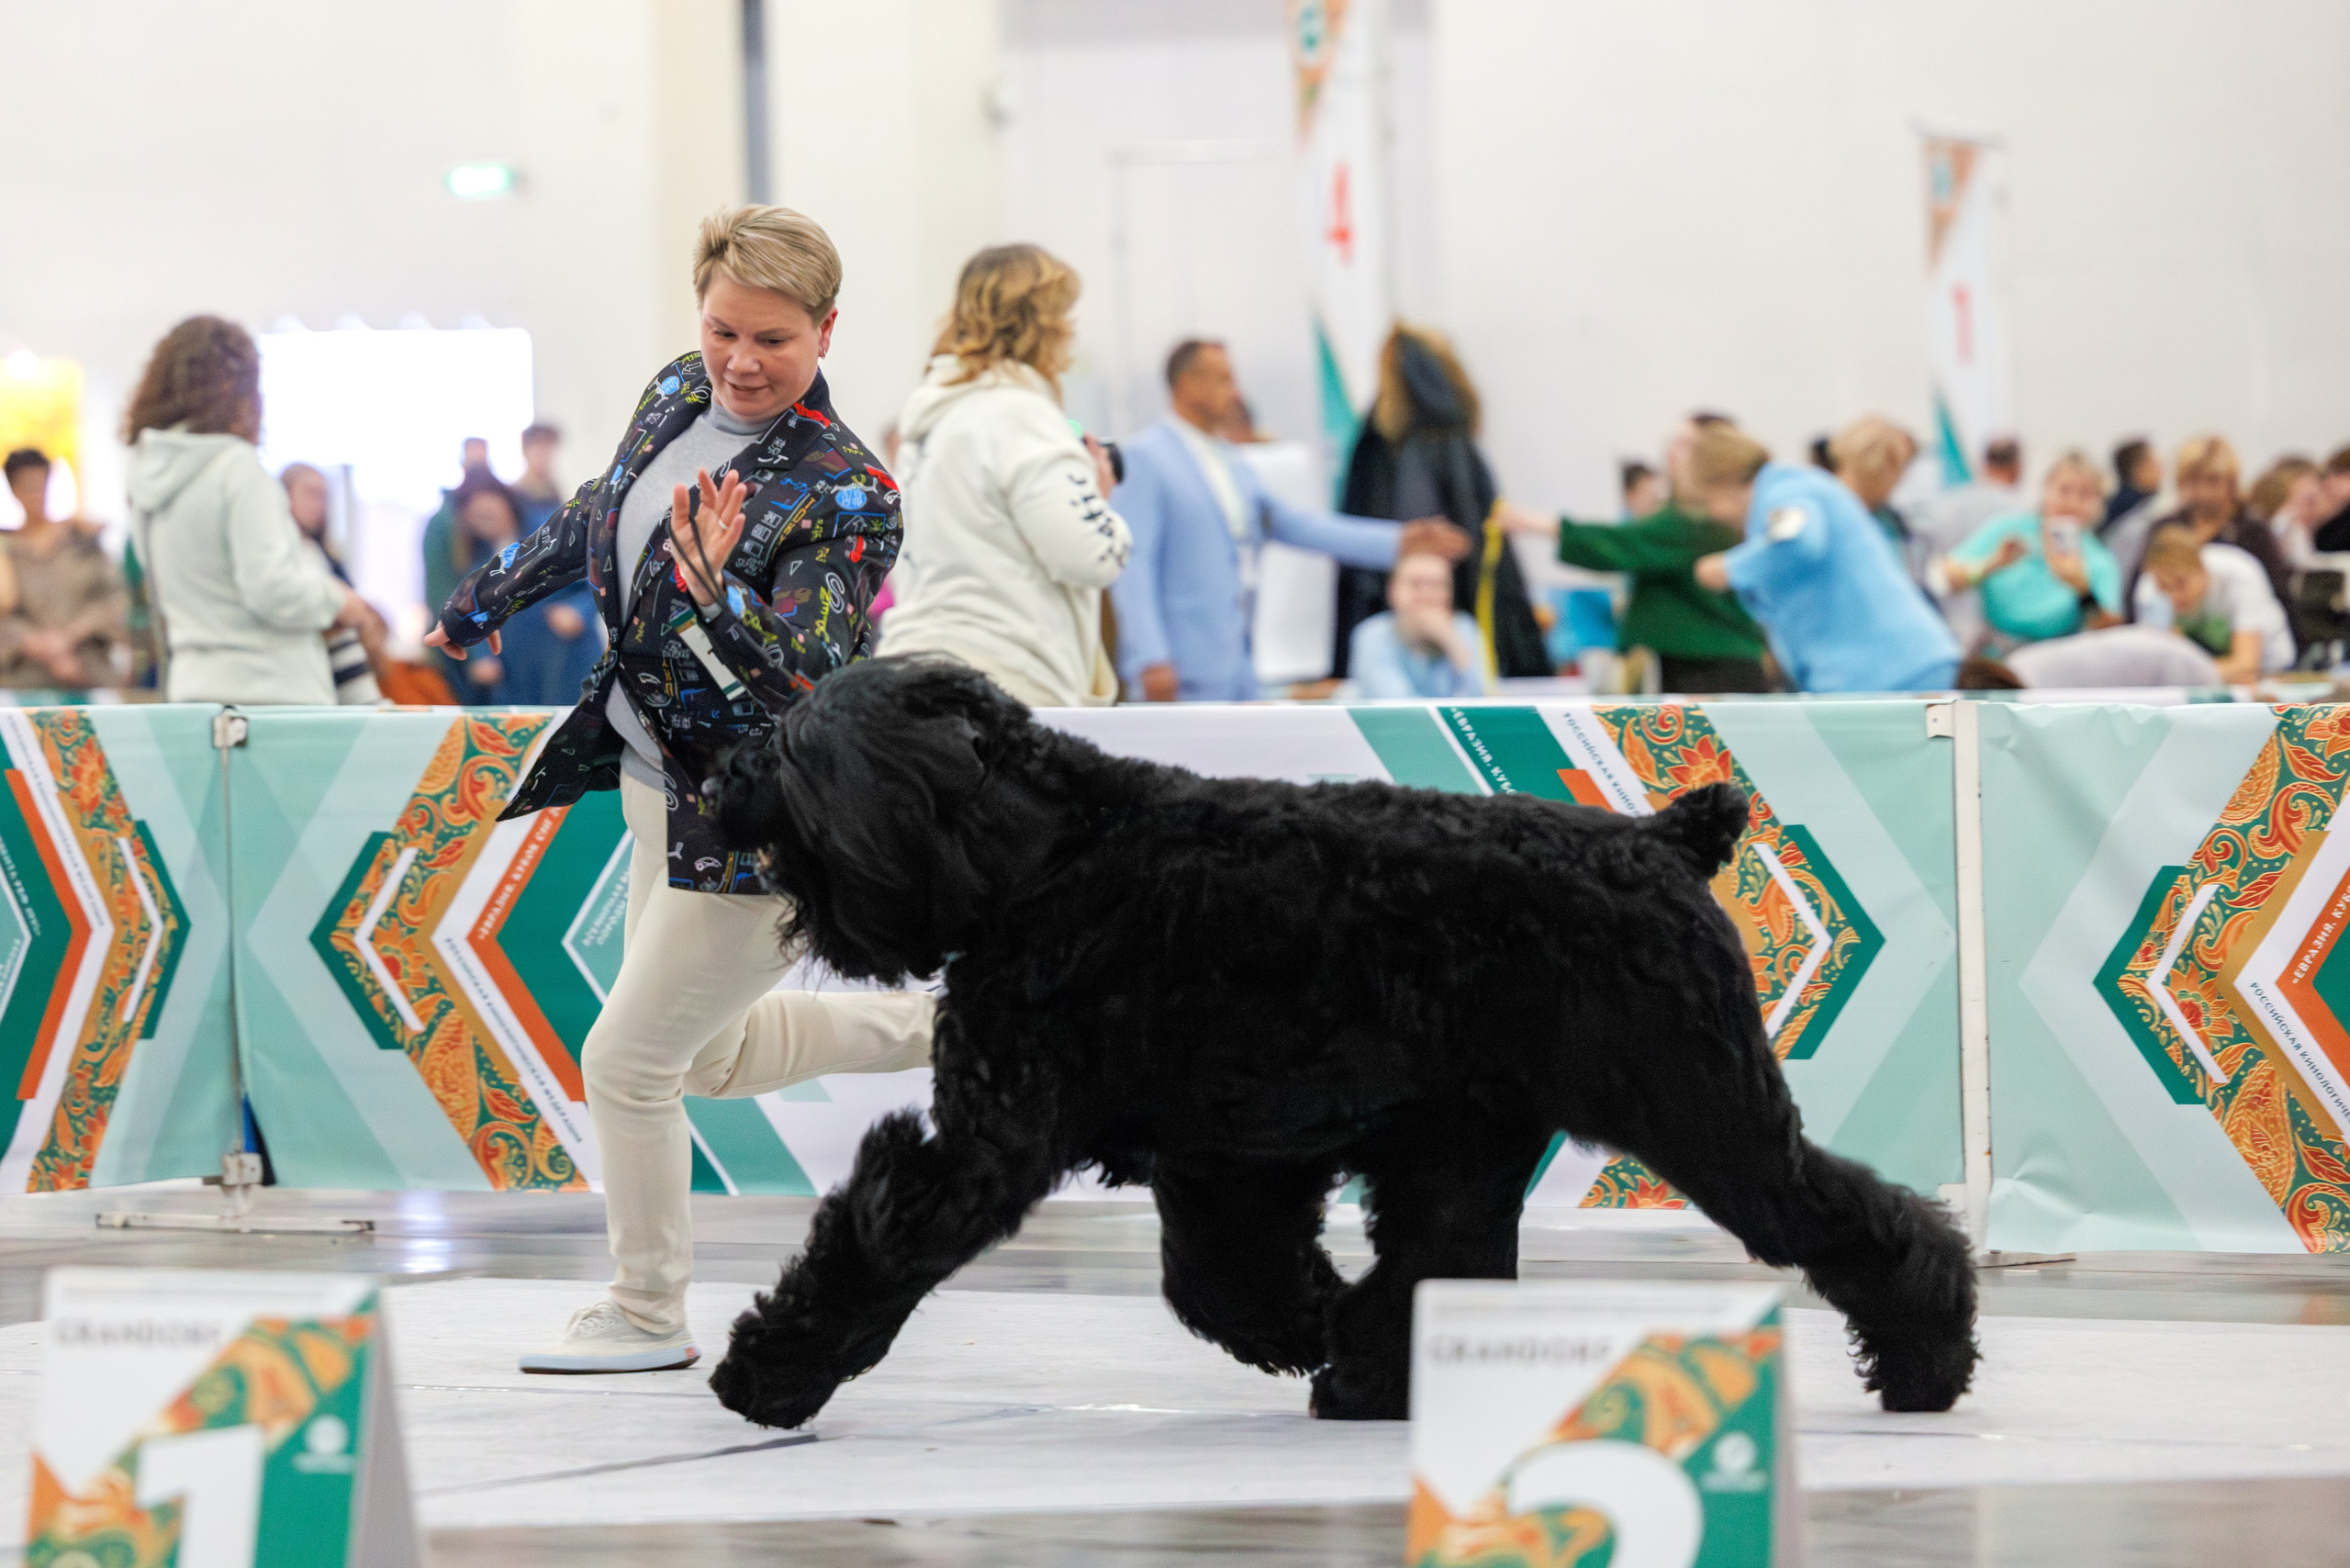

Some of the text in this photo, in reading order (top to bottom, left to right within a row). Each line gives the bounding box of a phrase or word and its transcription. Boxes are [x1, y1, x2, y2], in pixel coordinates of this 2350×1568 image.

[1563, 711, 1614, 781] РОССИЙСКАЯ
[2250, 981, 2350, 1125] РОССИЙСКАЯ КИНОЛОГИЧЕ
[137, 1424, 263, 1568] 1
